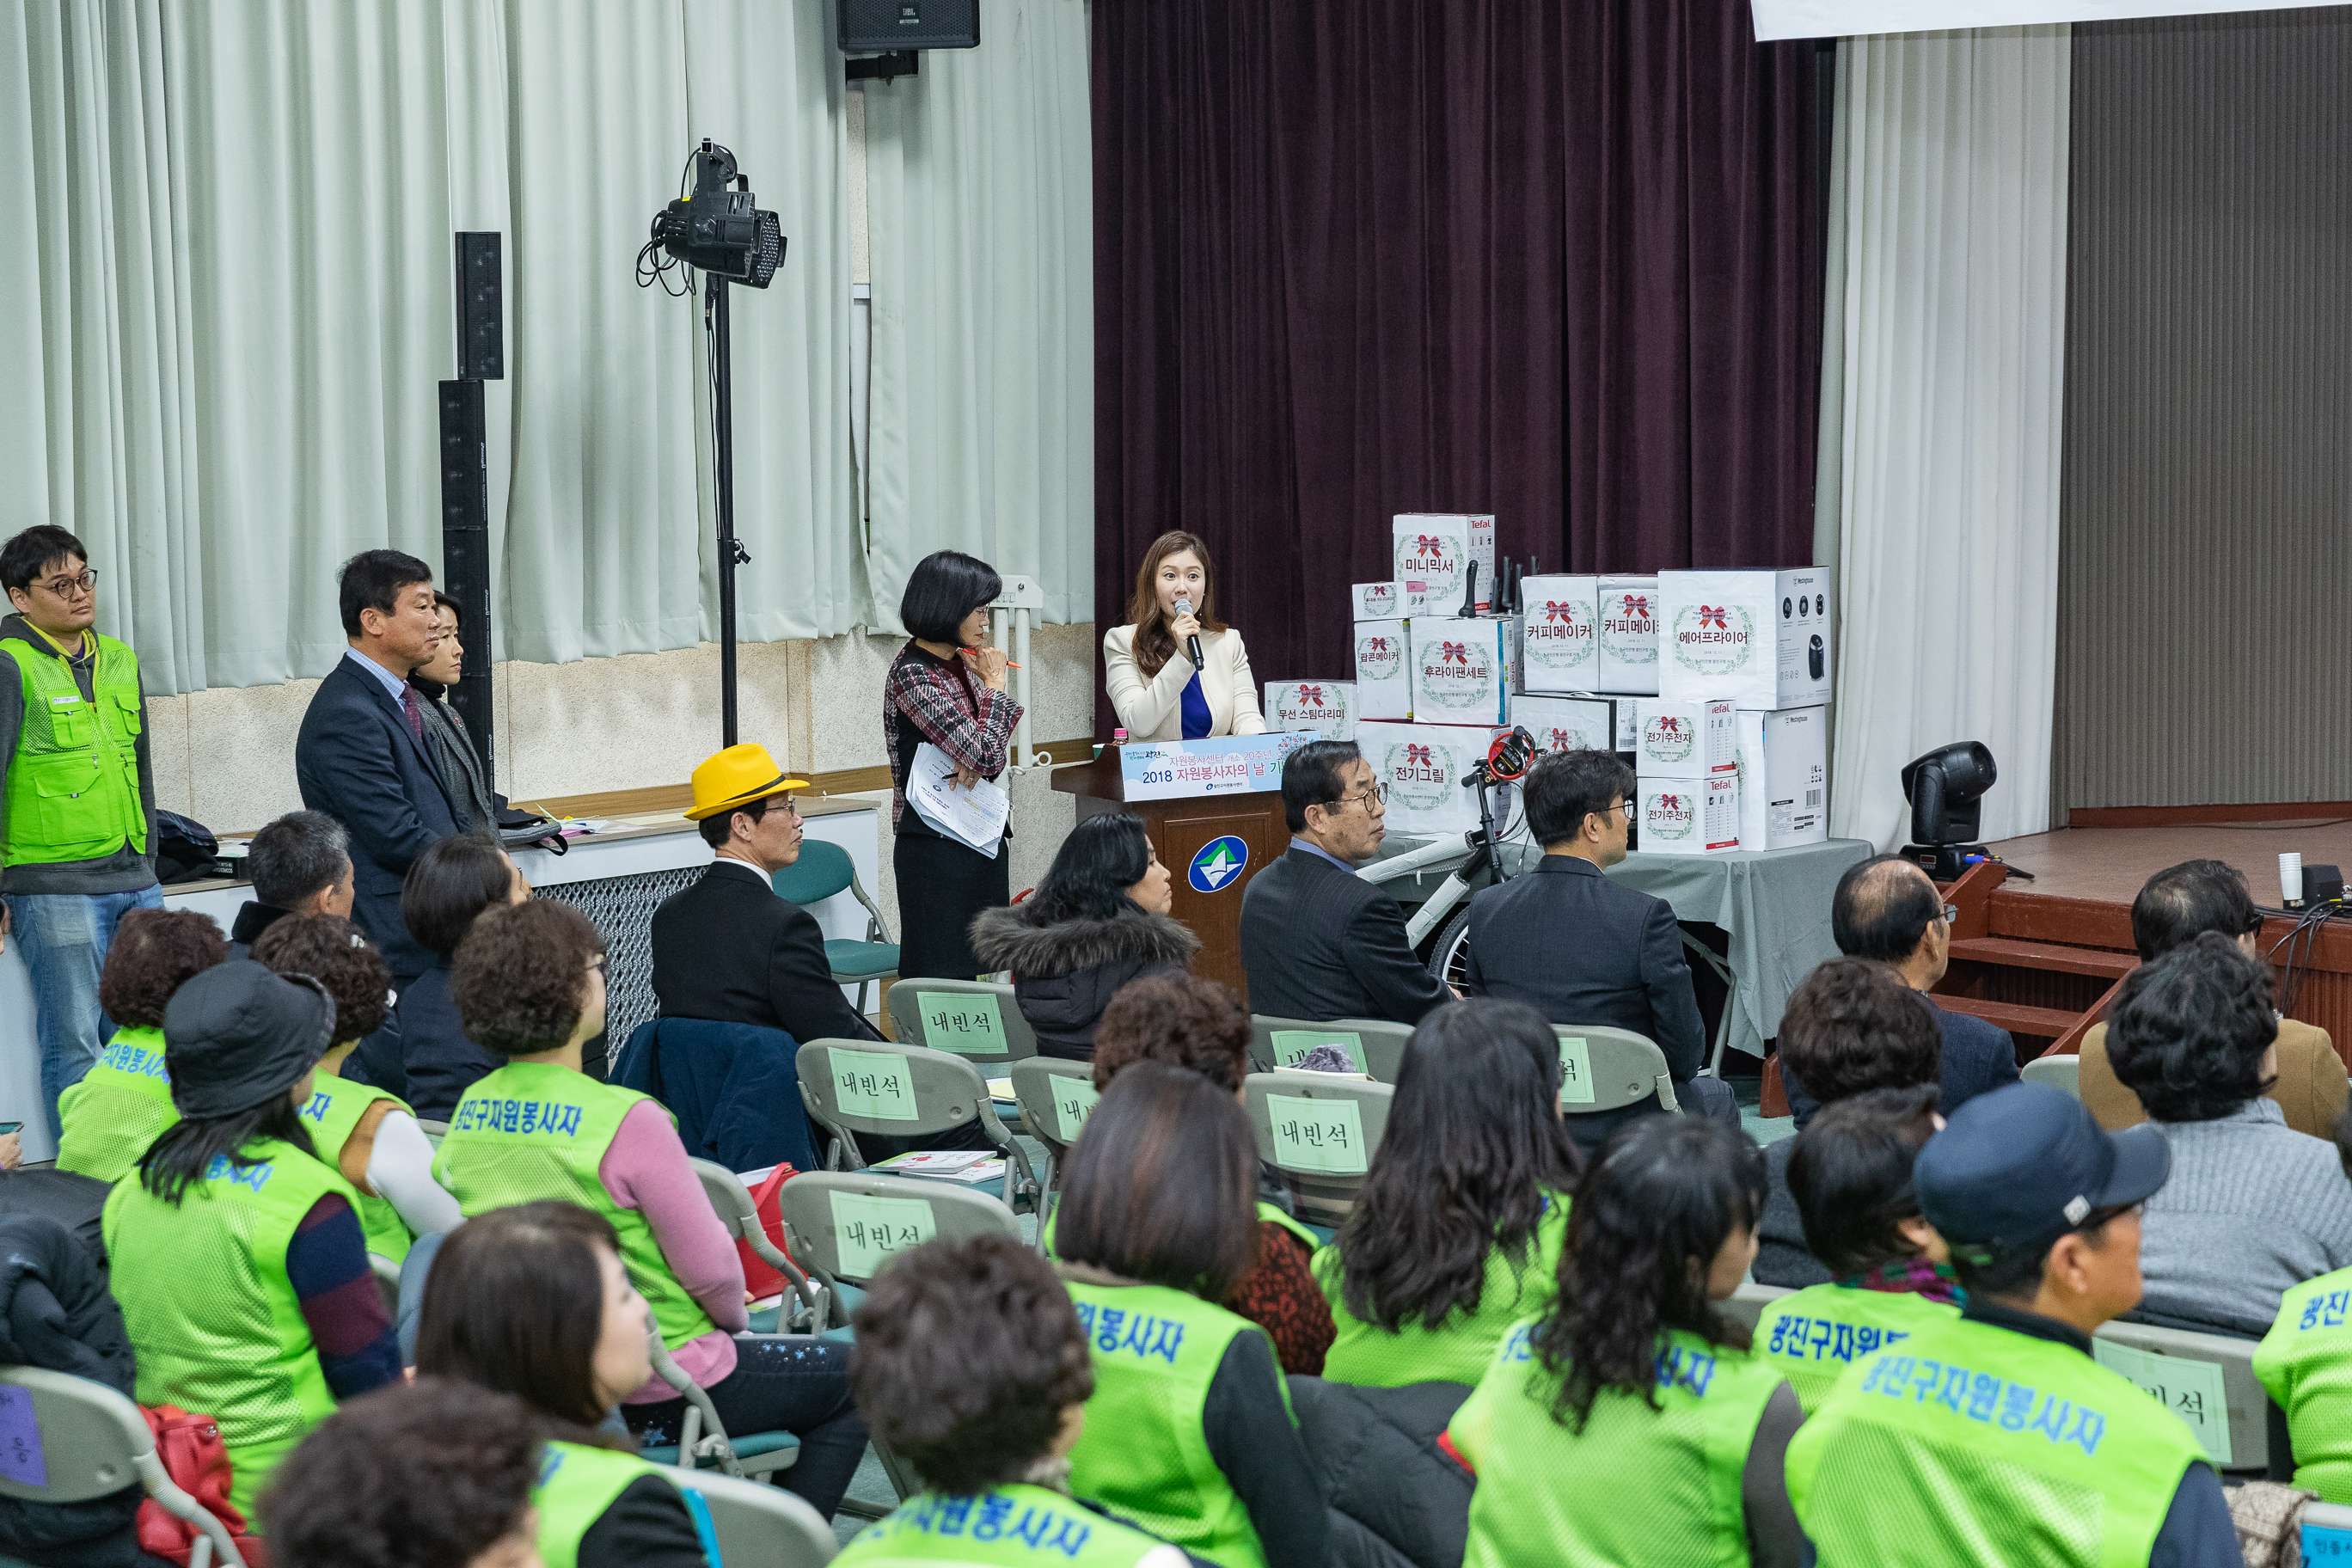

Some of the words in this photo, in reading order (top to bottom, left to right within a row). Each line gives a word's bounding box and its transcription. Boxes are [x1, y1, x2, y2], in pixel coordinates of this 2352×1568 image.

[1471, 520, 1491, 529] Tefal
[1406, 559, 1454, 573] 미니믹서
[1528, 624, 1592, 640] 커피메이커
[1605, 619, 1659, 634] 커피메이
[1679, 631, 1748, 645] 에어프라이어
[1360, 652, 1399, 663] 팝콘메이커
[1424, 665, 1487, 679] 후라이팬세트
[1278, 709, 1296, 720] 무선
[1300, 708, 1345, 720] 스팀다리미
[1647, 732, 1692, 744] 전기주전자
[1169, 753, 1224, 767] 자원봉사센터
[1243, 750, 1272, 762] 20주년
[1142, 769, 1173, 784] 2018
[1177, 763, 1249, 782] 자원봉사자의
[1253, 762, 1265, 776] 날
[1270, 762, 1283, 775] 기
[1396, 767, 1444, 783] 전기그릴
[1711, 780, 1731, 791] Tefal
[1649, 810, 1692, 821] 전기주전자
[931, 1011, 990, 1033] 내빈석
[841, 1071, 900, 1099] 내빈석
[1281, 1119, 1347, 1149] 내빈석
